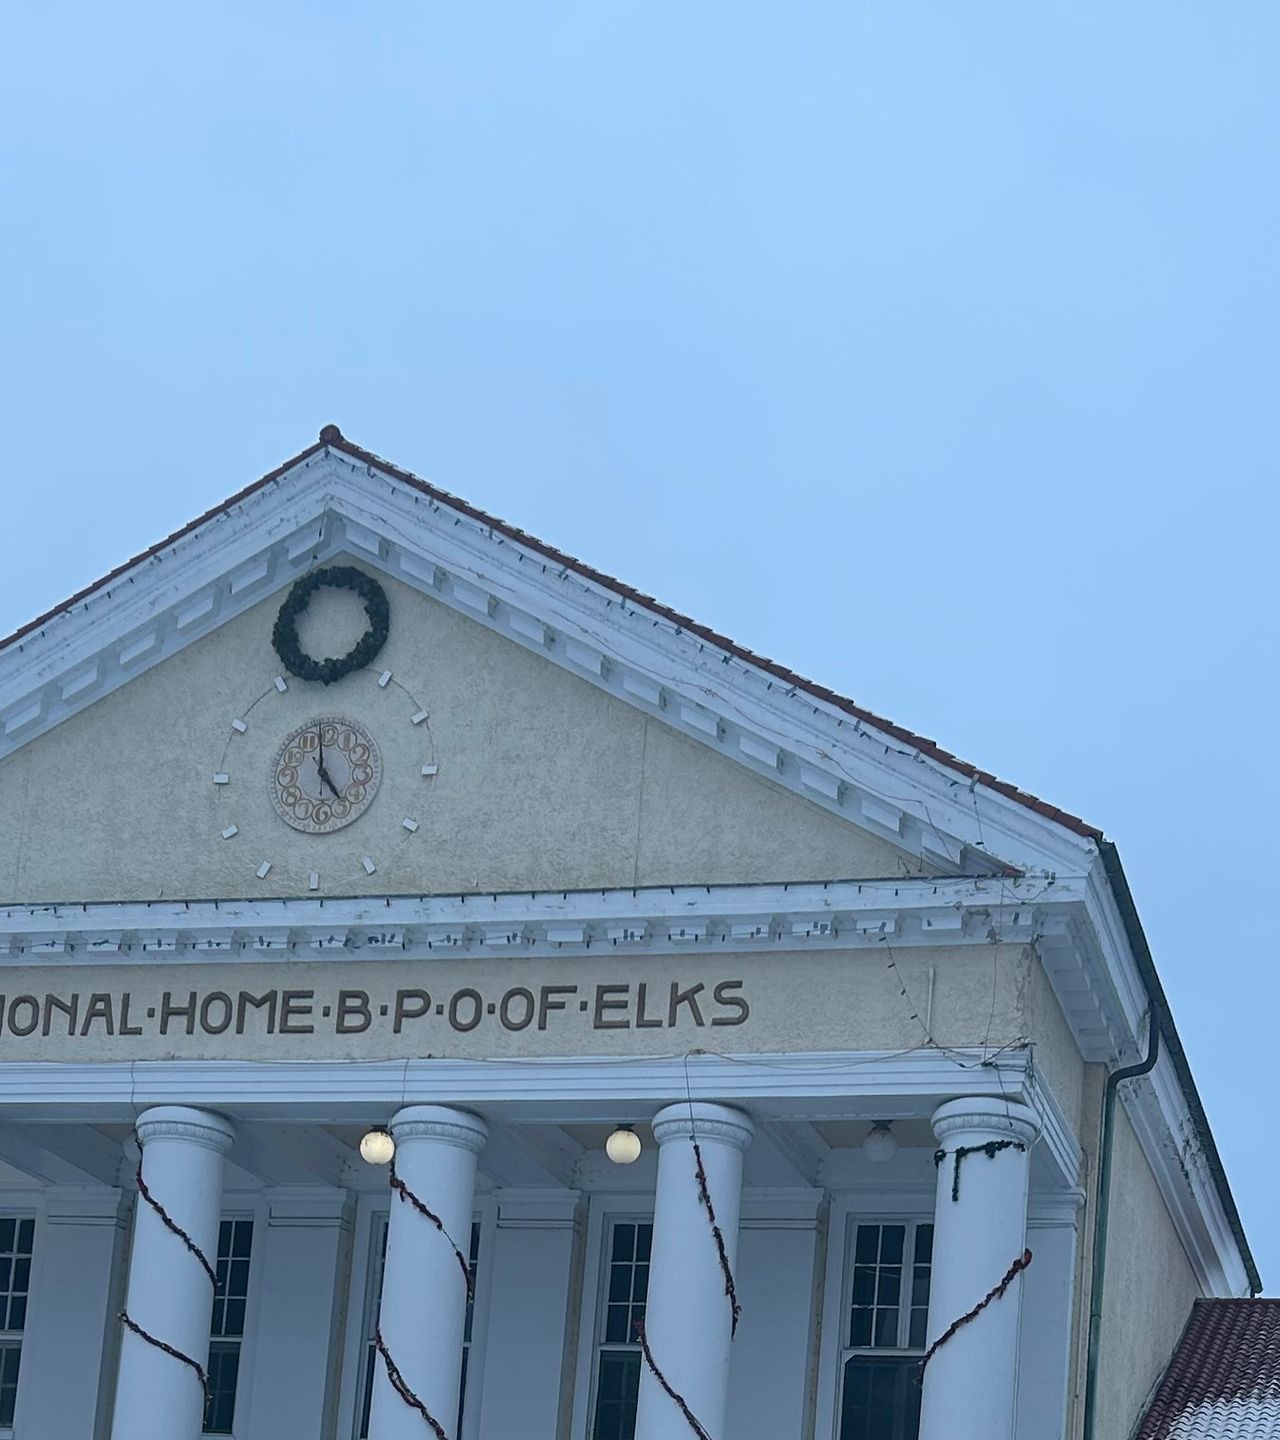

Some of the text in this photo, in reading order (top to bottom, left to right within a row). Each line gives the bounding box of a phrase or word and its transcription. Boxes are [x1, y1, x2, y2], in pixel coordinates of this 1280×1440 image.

[302, 735, 316, 749] 11
[322, 727, 337, 744] 12
[343, 732, 351, 749] 1
[288, 750, 302, 764] 10
[352, 745, 367, 764] 2
[281, 768, 296, 786] 9
[355, 766, 370, 784] 3
[285, 786, 298, 805] 8
[348, 784, 363, 801] 4
[298, 801, 310, 818] 7
[315, 805, 329, 823] 6
[334, 798, 348, 816] 5
[159, 989, 314, 1035] HOME
[500, 985, 578, 1031] OF
[593, 980, 750, 1030] ELKS
